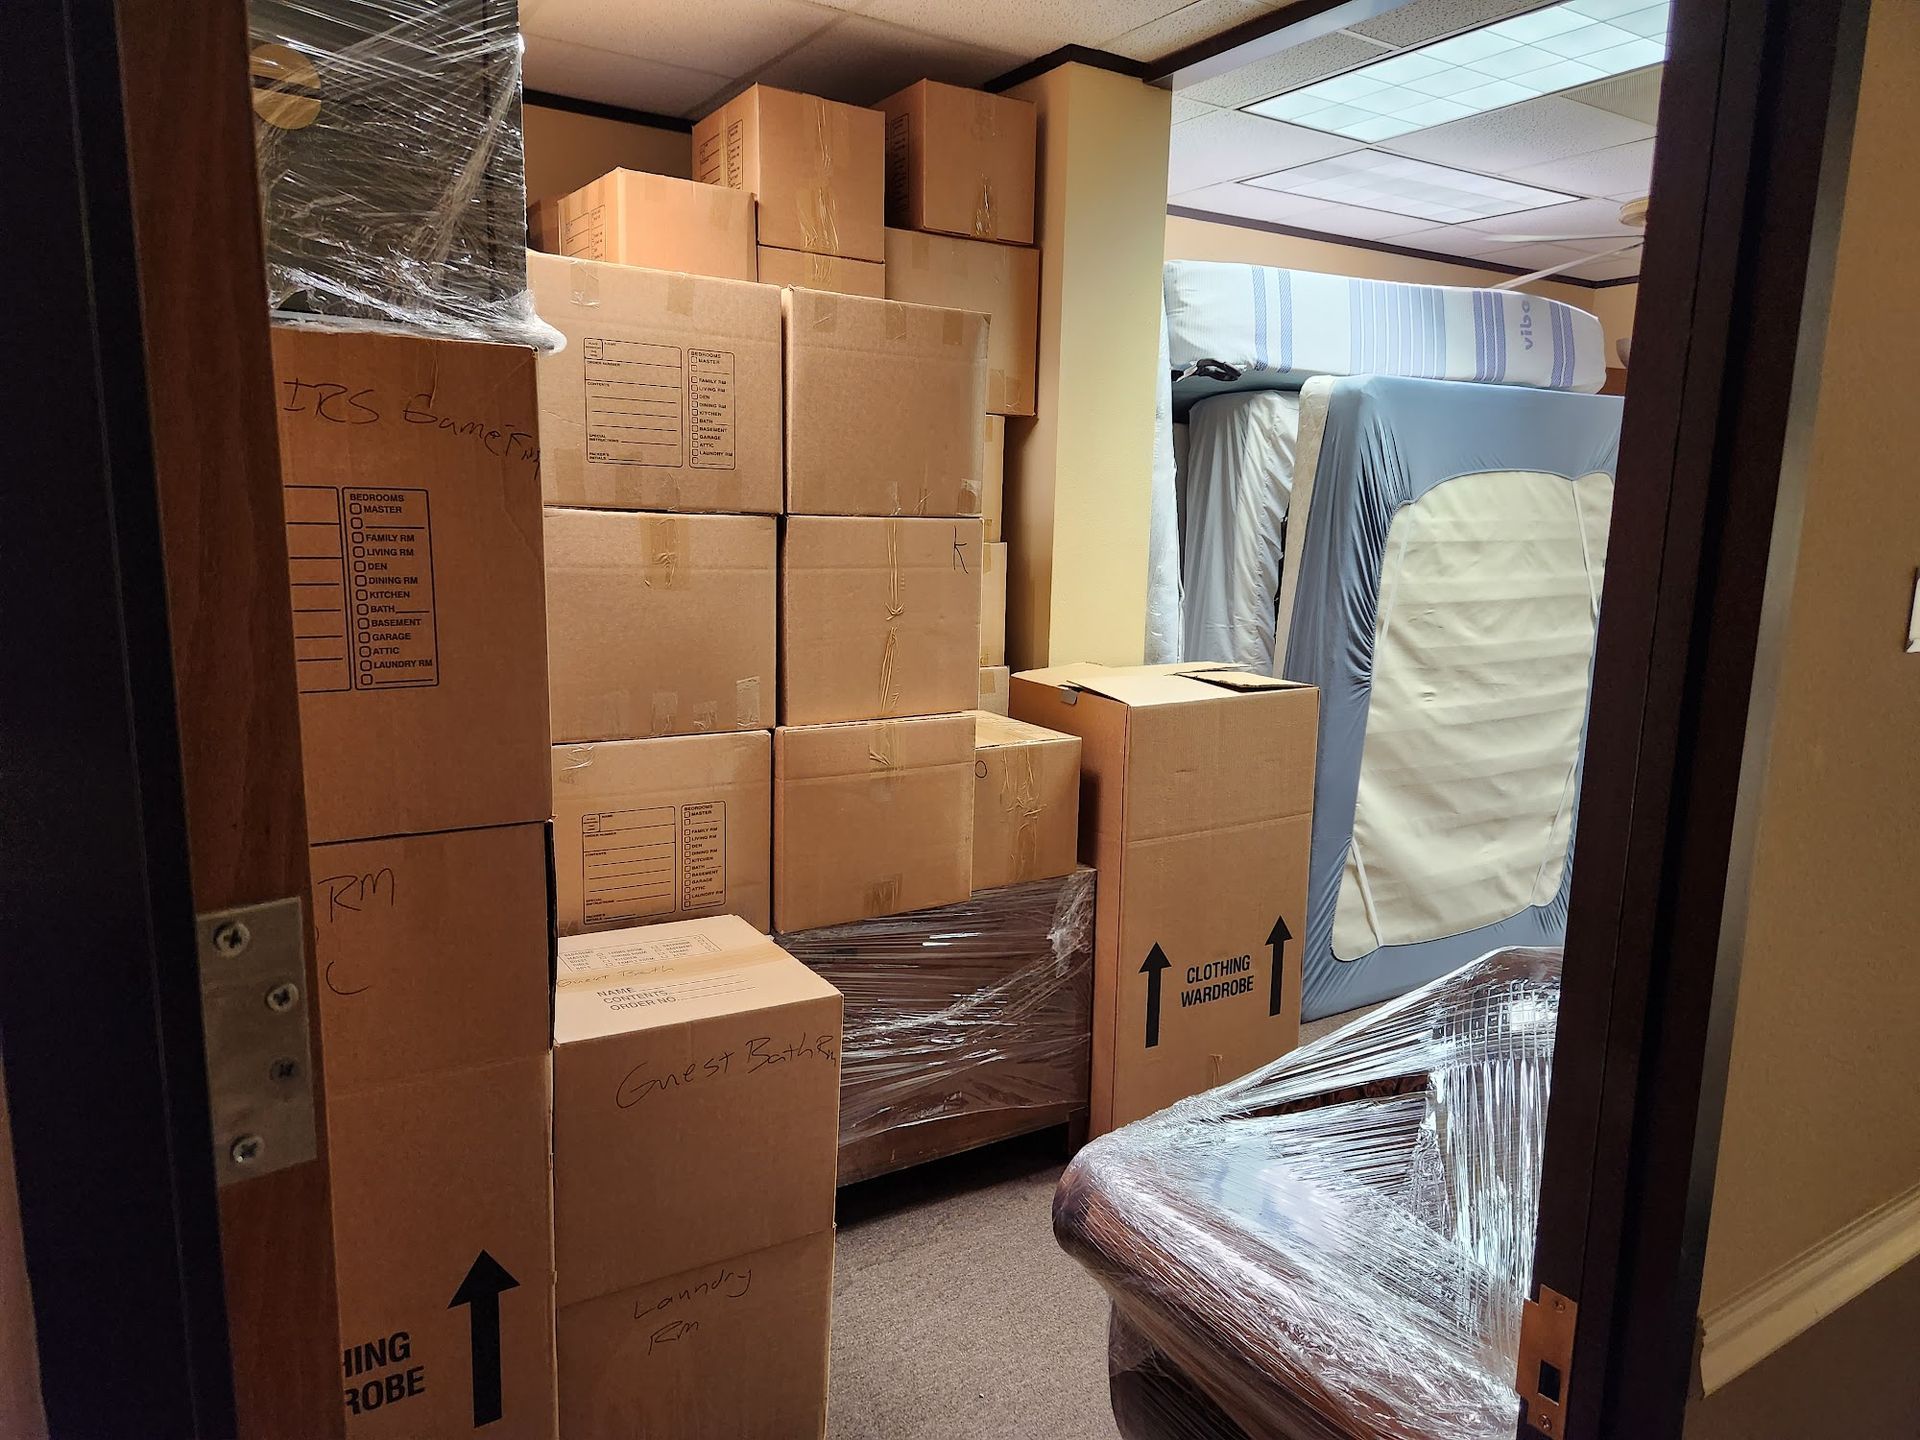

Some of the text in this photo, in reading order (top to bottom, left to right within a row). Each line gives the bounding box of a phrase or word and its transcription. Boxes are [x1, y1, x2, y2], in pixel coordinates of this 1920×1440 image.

[350, 494, 404, 502] BEDROOMS
[364, 506, 402, 514] MASTER
[366, 534, 414, 542] FAMILY RM
[366, 548, 414, 556] LIVING RM
[953, 524, 968, 575] K
[372, 619, 422, 627] BASEMENT
[373, 647, 400, 655] ATTIC
[374, 660, 417, 668] LAUNDRY
[1187, 955, 1250, 984] CLOTHING
[597, 987, 636, 998] NAME
[603, 990, 668, 1004] CONTENTS
[1181, 975, 1254, 1008] WARDROBE
[610, 1001, 655, 1012] ORDER
[616, 1050, 736, 1109] Guest
[634, 1269, 752, 1319] Laundry
[344, 1365, 425, 1415] ROBE
